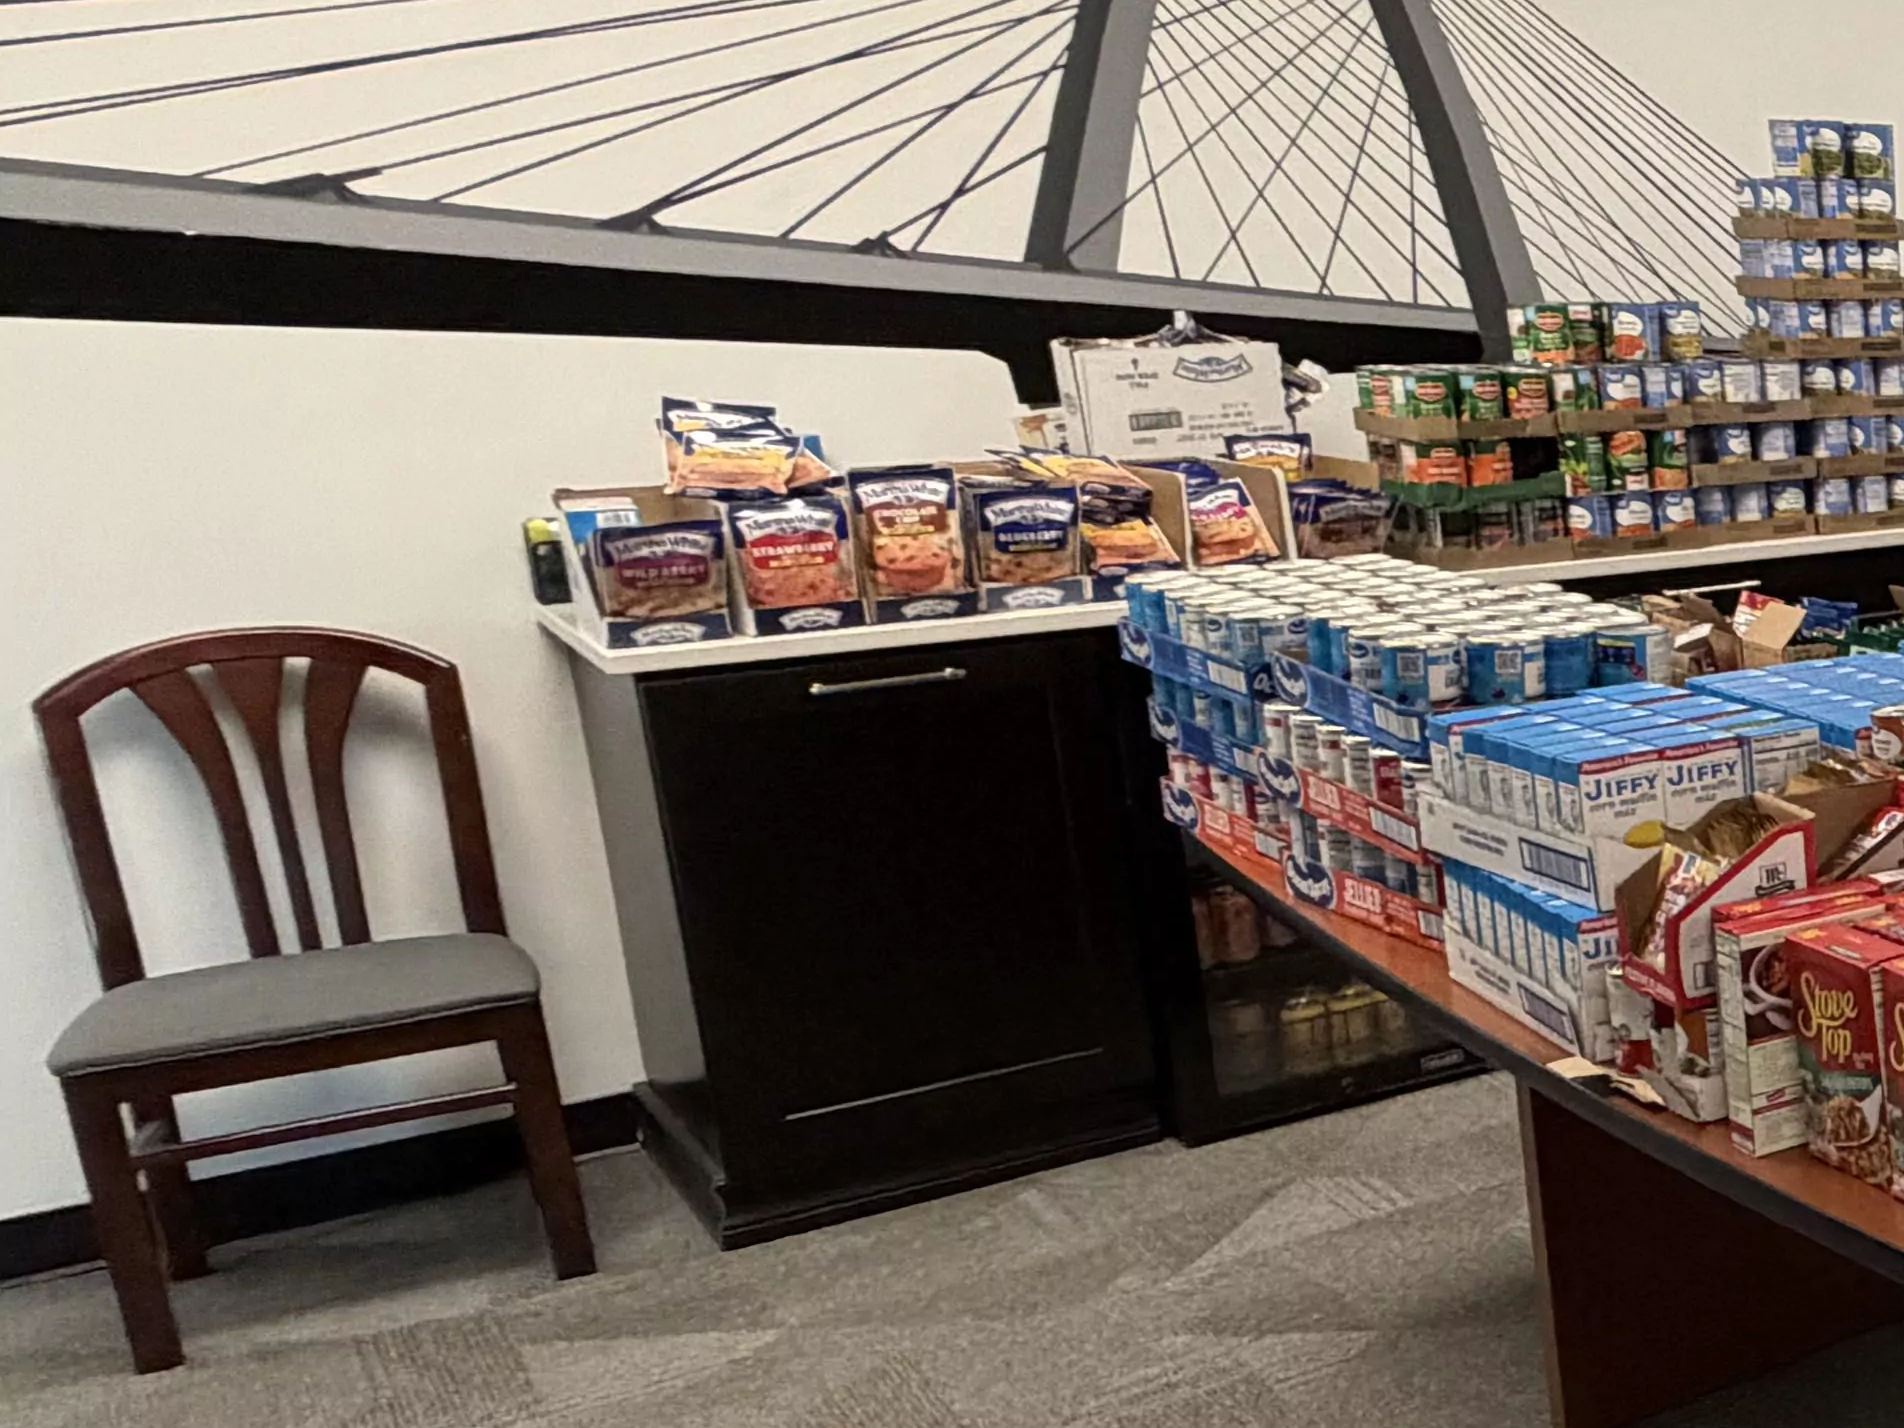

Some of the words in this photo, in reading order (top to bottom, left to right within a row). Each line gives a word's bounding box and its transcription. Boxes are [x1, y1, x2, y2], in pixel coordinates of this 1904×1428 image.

[1584, 774, 1659, 801] JIFFY
[1667, 760, 1738, 786] JIFFY
[1799, 972, 1858, 1038] Stove
[1817, 1018, 1853, 1063] Top
